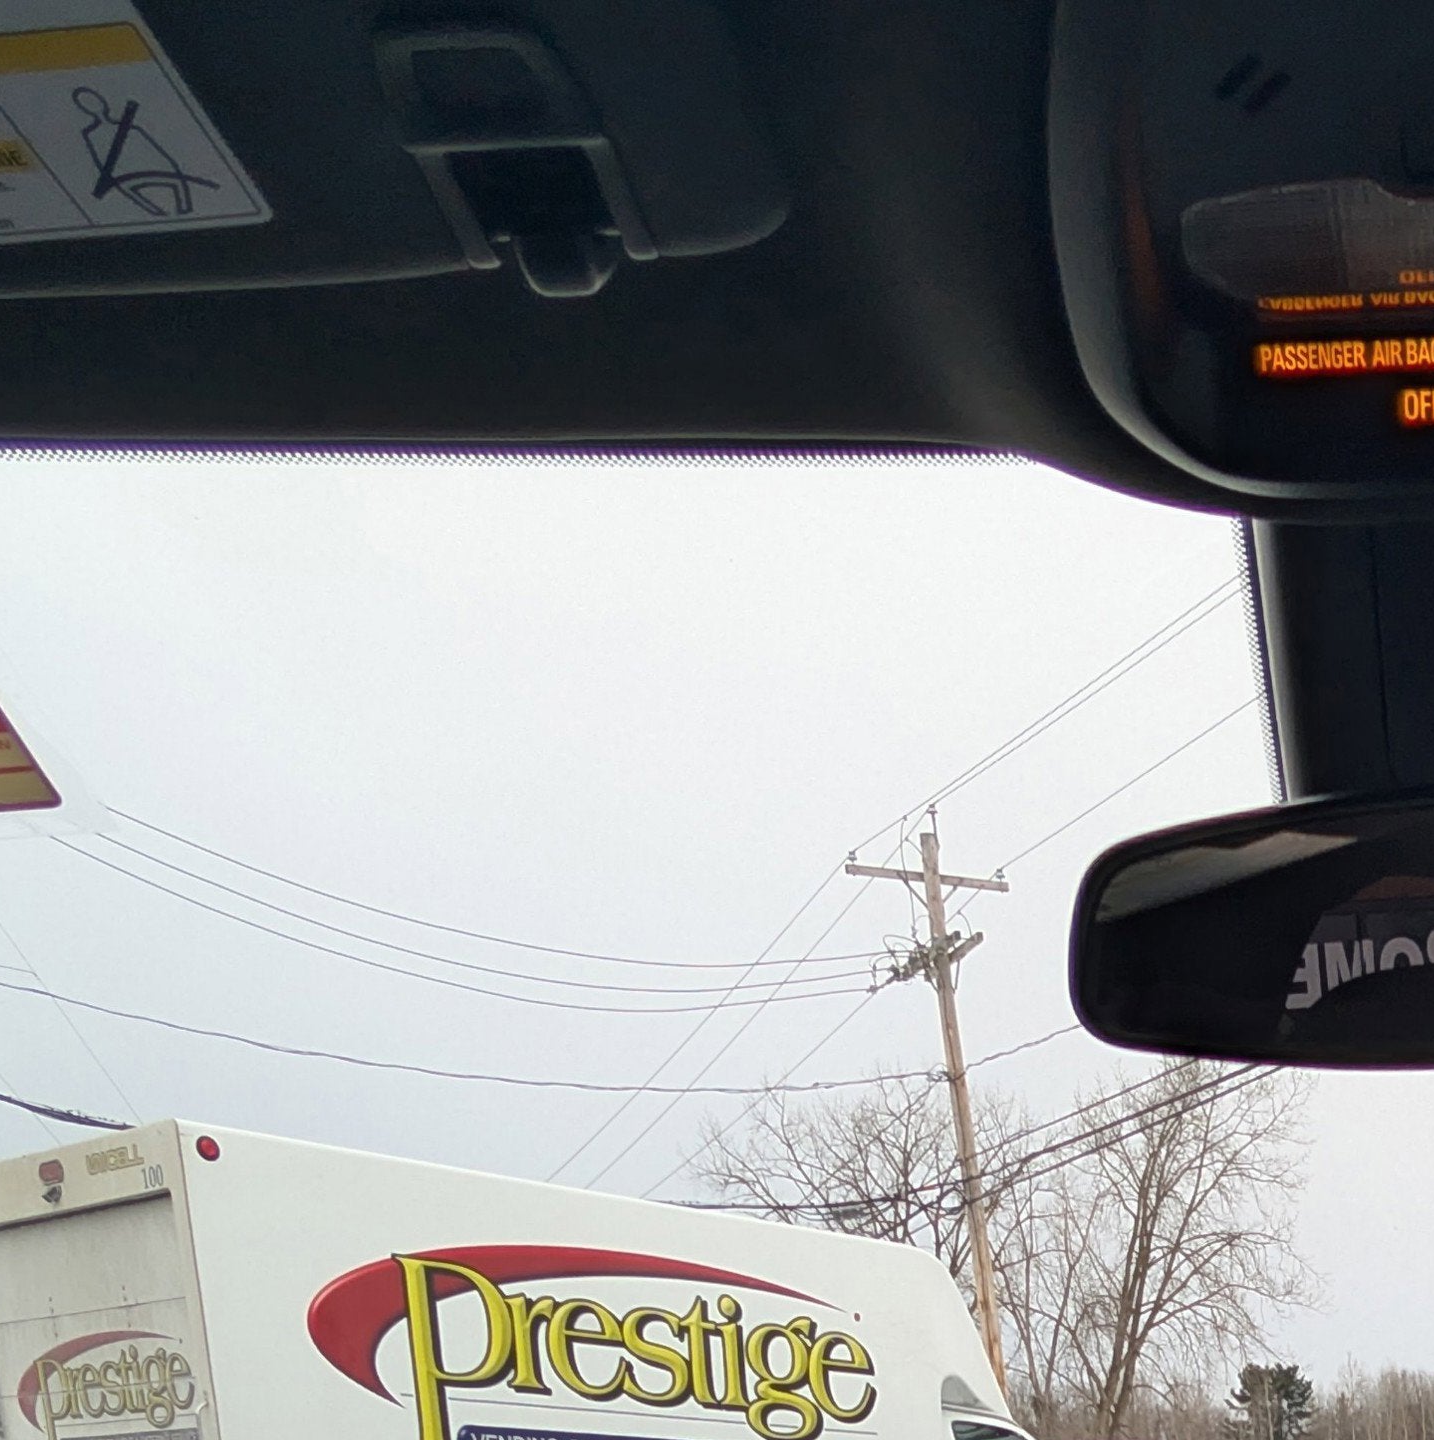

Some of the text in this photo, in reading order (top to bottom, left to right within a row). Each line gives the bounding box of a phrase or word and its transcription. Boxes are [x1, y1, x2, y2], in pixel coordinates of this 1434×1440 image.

[1260, 342, 1366, 371] PASSENGER
[1373, 340, 1404, 367] AIR
[142, 1164, 165, 1190] 100
